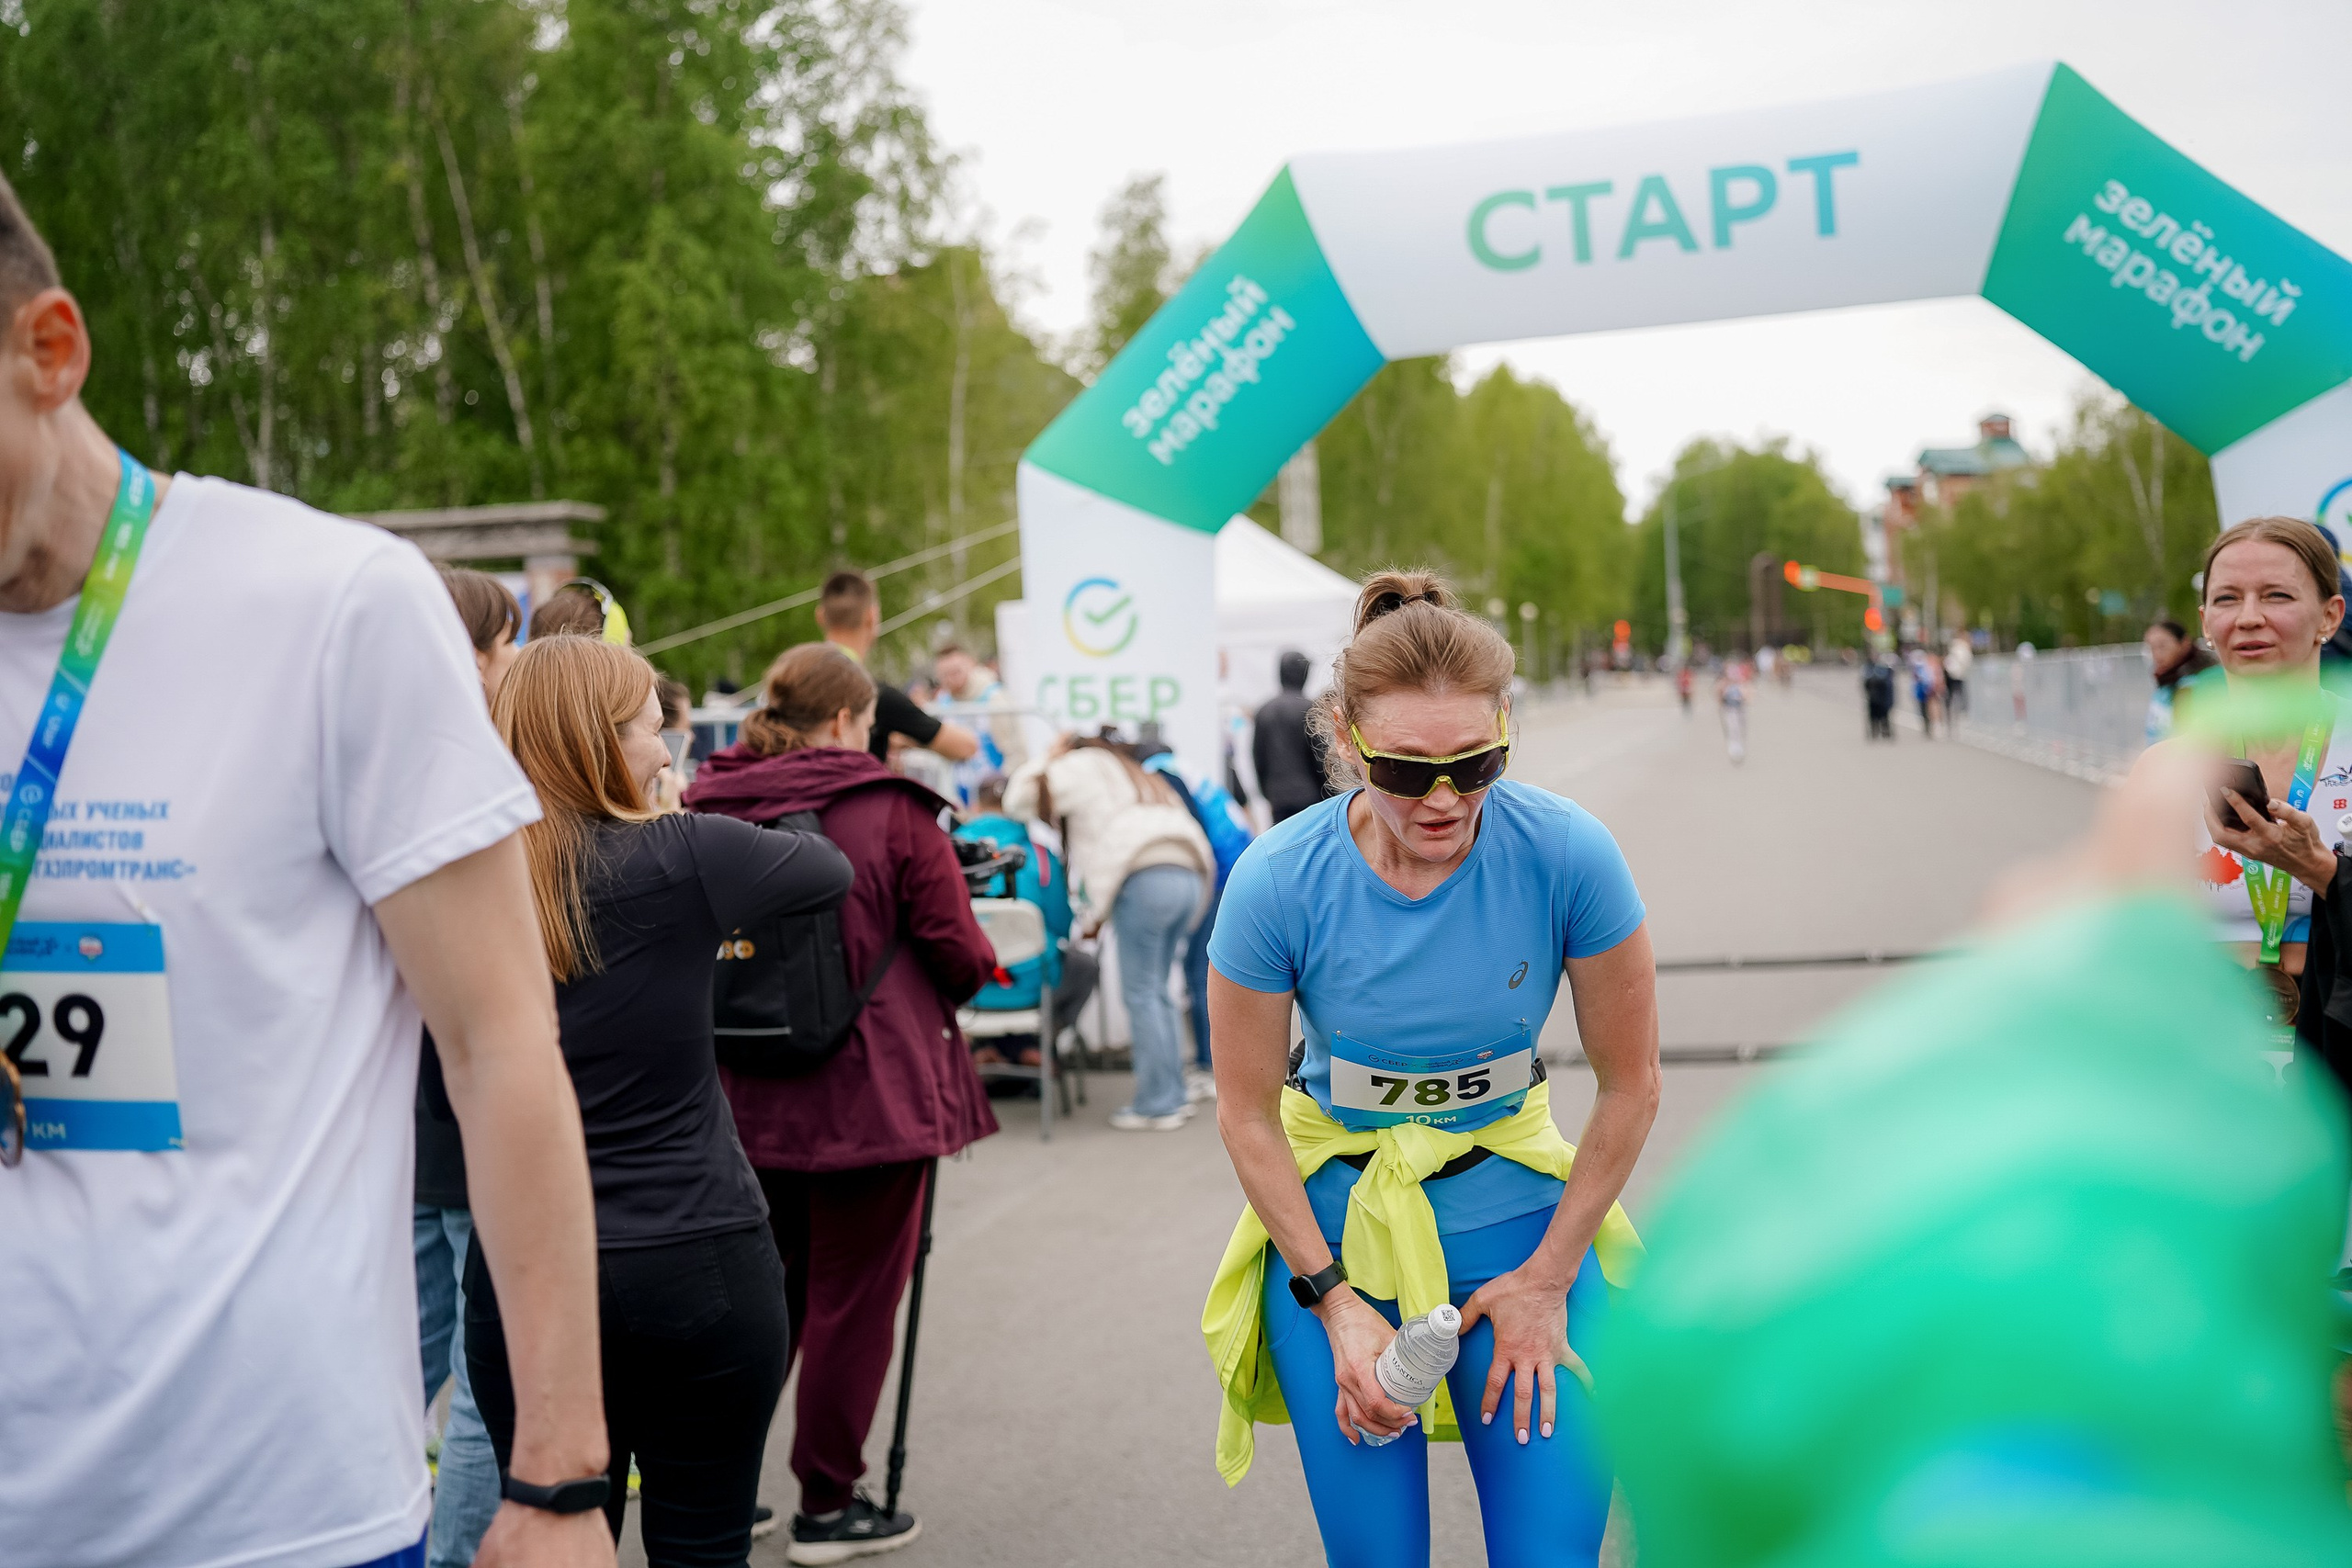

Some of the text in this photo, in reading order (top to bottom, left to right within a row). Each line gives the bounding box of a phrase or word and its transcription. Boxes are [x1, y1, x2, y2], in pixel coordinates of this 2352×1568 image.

[1465, 151, 1860, 272] СТАРТ
[2093, 178, 2303, 327] зелёный
[2064, 211, 2266, 363] марафон
[1122, 275, 1268, 439] зелёный
[1148, 305, 1296, 466] марафон
[0, 991, 105, 1077] 29
[1370, 1067, 1491, 1107] 785
[1406, 1114, 1431, 1125] 10
